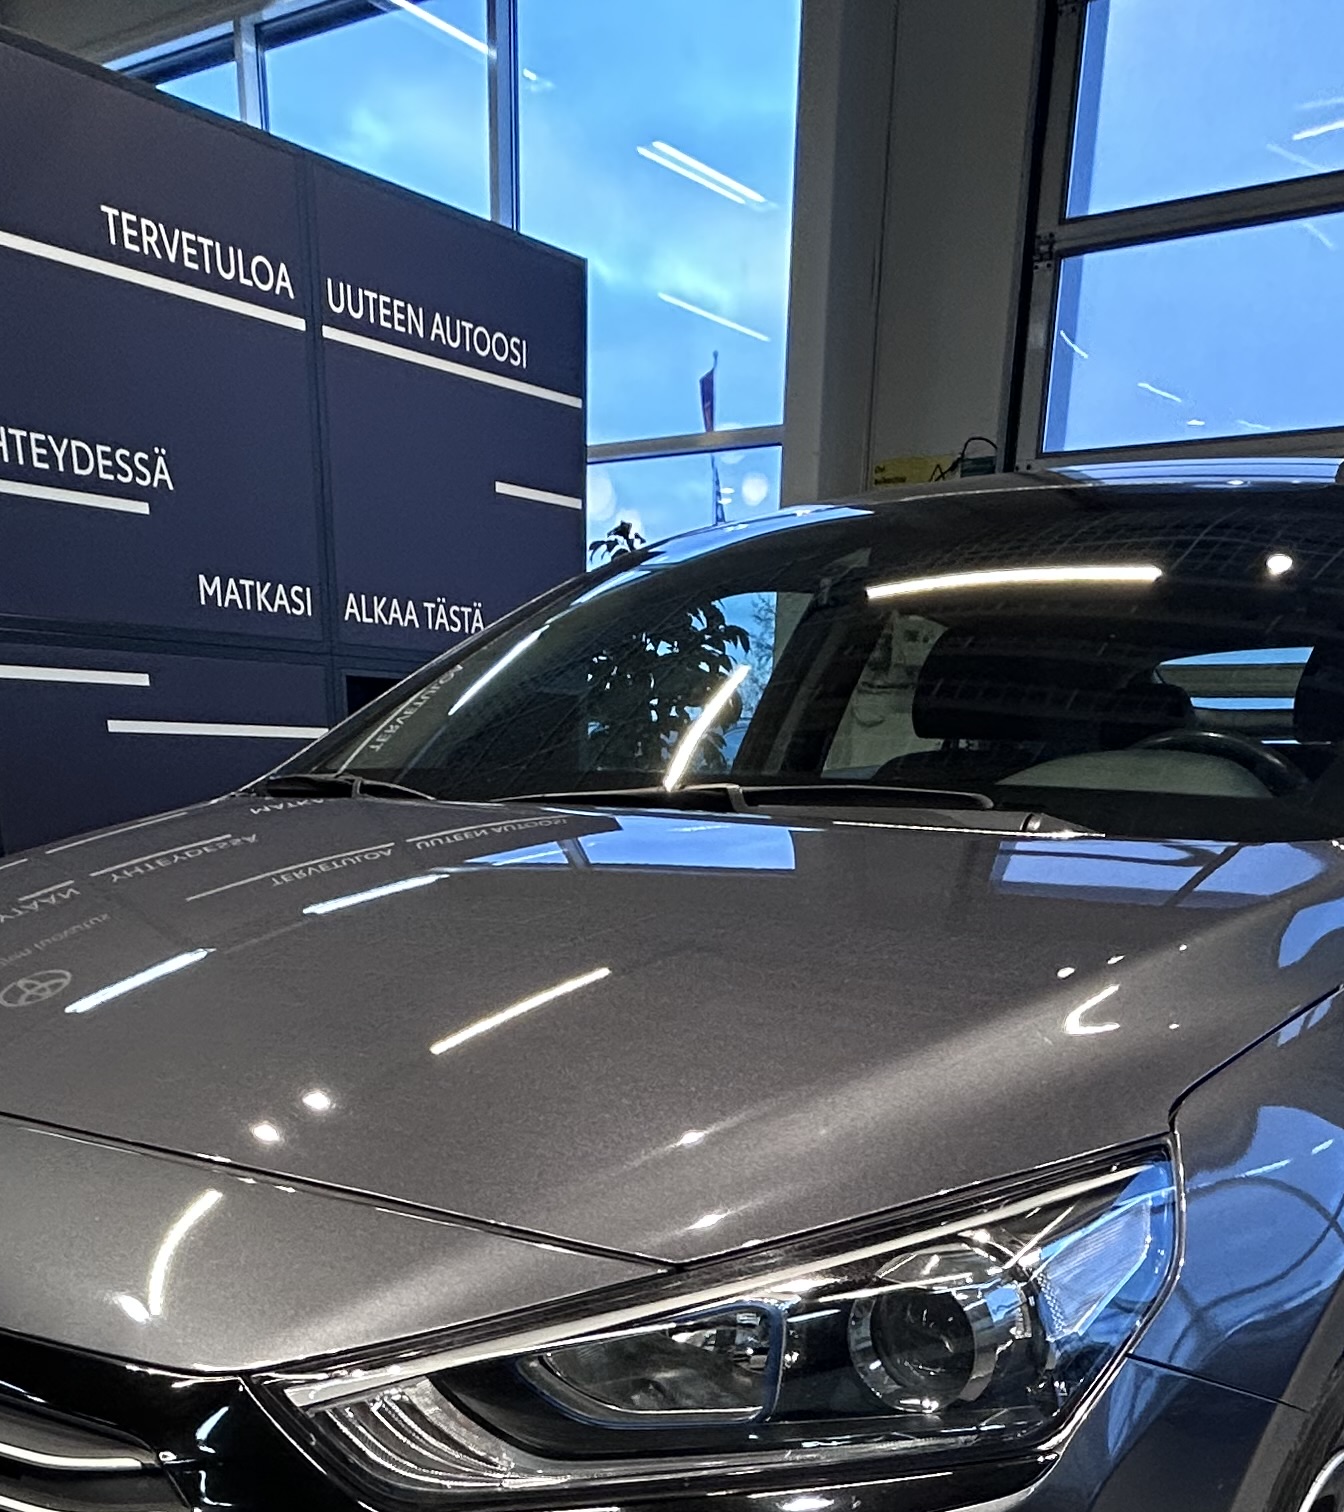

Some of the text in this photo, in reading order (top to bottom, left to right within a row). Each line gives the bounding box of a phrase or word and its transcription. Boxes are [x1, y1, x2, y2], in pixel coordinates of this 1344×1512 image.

[101, 205, 527, 369] TERVETULOA UUTEEN AUTOOSI
[198, 575, 484, 634] MATKASI ALKAA TÄSTÄ
